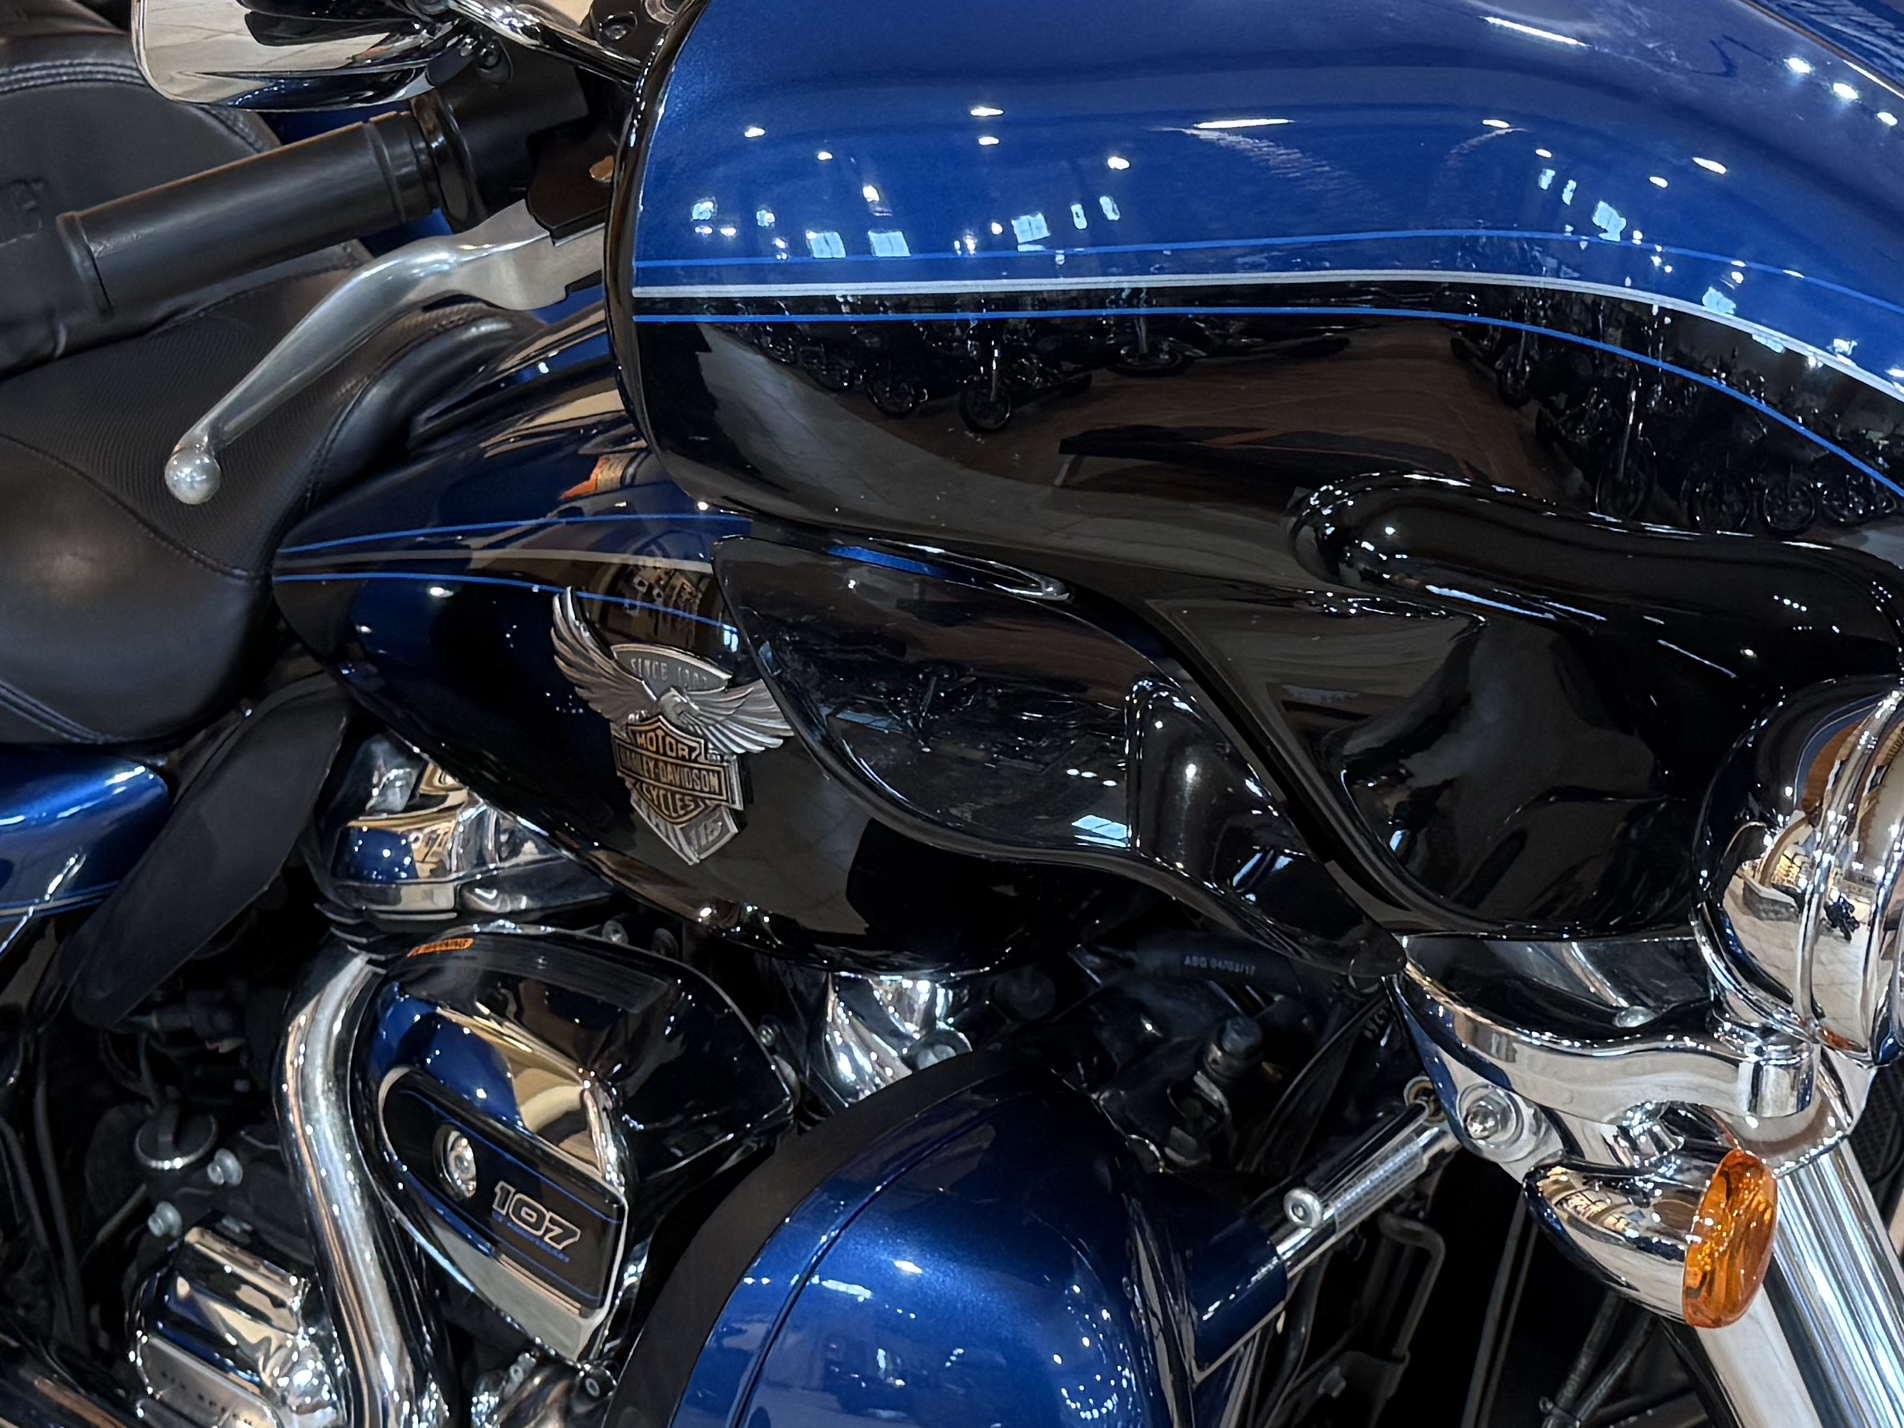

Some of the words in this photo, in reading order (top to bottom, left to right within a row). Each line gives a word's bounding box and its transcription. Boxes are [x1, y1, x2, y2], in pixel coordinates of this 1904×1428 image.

[636, 729, 690, 759] MOTOR
[617, 743, 720, 793] HARLEY-DAVIDSON
[643, 784, 696, 817] CYCLES
[492, 1180, 581, 1251] 107
